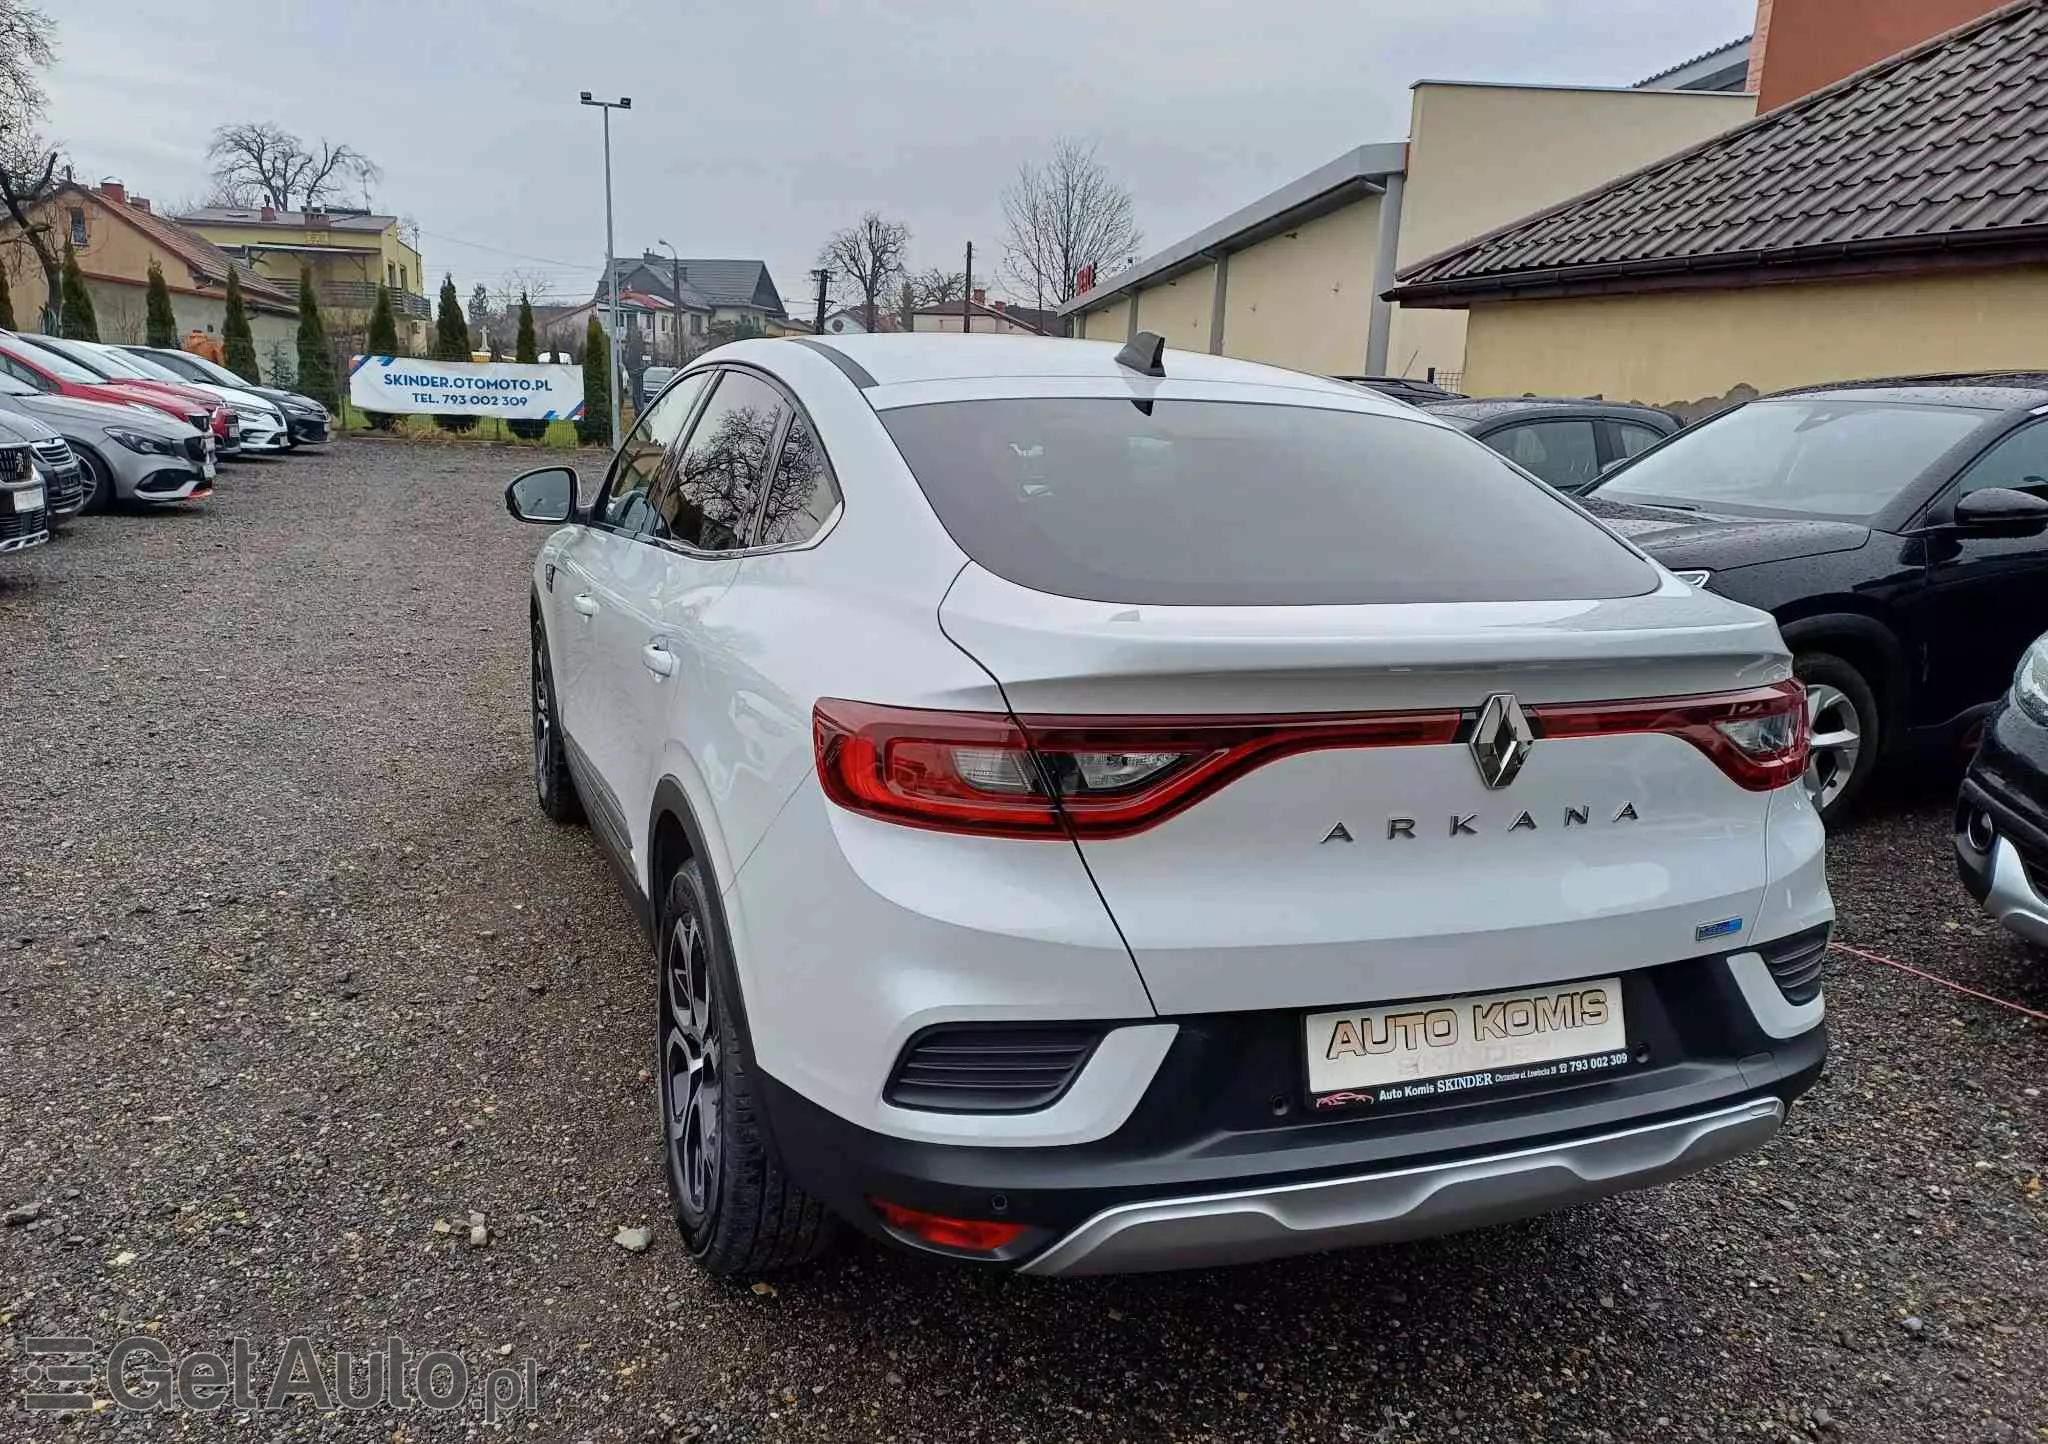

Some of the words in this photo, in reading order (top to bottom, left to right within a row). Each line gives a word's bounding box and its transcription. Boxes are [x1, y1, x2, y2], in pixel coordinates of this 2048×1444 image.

[384, 374, 552, 391] SKINDER.OTOMOTO.PL
[412, 392, 439, 404] TEL.
[443, 394, 466, 405] 793
[470, 395, 498, 406] 002
[502, 396, 528, 406] 309
[1320, 801, 1639, 844] ARKANA
[1326, 1008, 1458, 1060] AUTO
[1472, 989, 1609, 1041] KOMIS
[1379, 1089, 1402, 1101] Auto
[1404, 1083, 1435, 1097] Komis
[1437, 1073, 1493, 1093] SKINDER
[1569, 1060, 1589, 1073] 793
[1590, 1056, 1608, 1069] 002
[1610, 1052, 1628, 1064] 309
